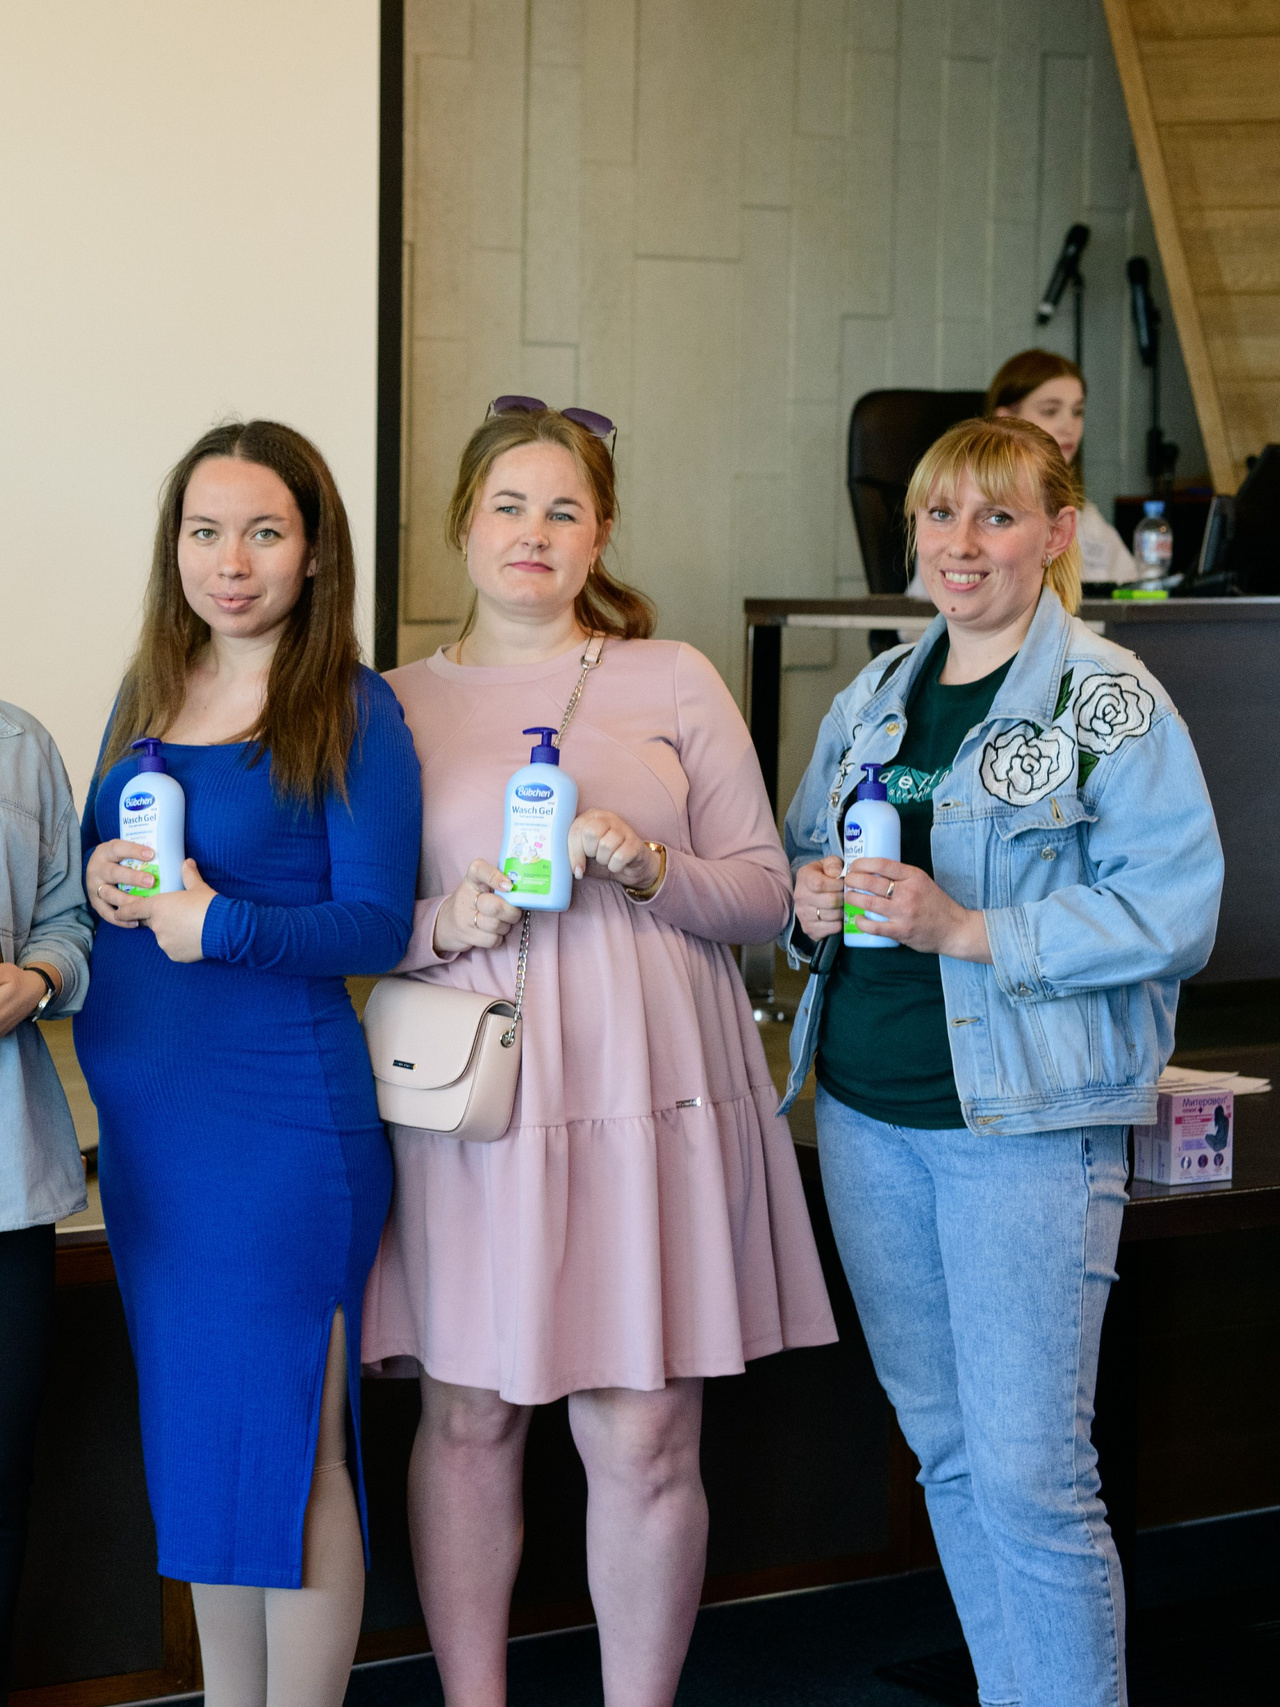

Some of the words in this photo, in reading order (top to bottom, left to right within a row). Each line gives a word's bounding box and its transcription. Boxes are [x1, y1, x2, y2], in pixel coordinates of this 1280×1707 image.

[512, 805, 538, 815] Wasch
[538, 806, 554, 816] Gel
[122, 814, 143, 825] Wasch
[143, 813, 157, 823] Gel
